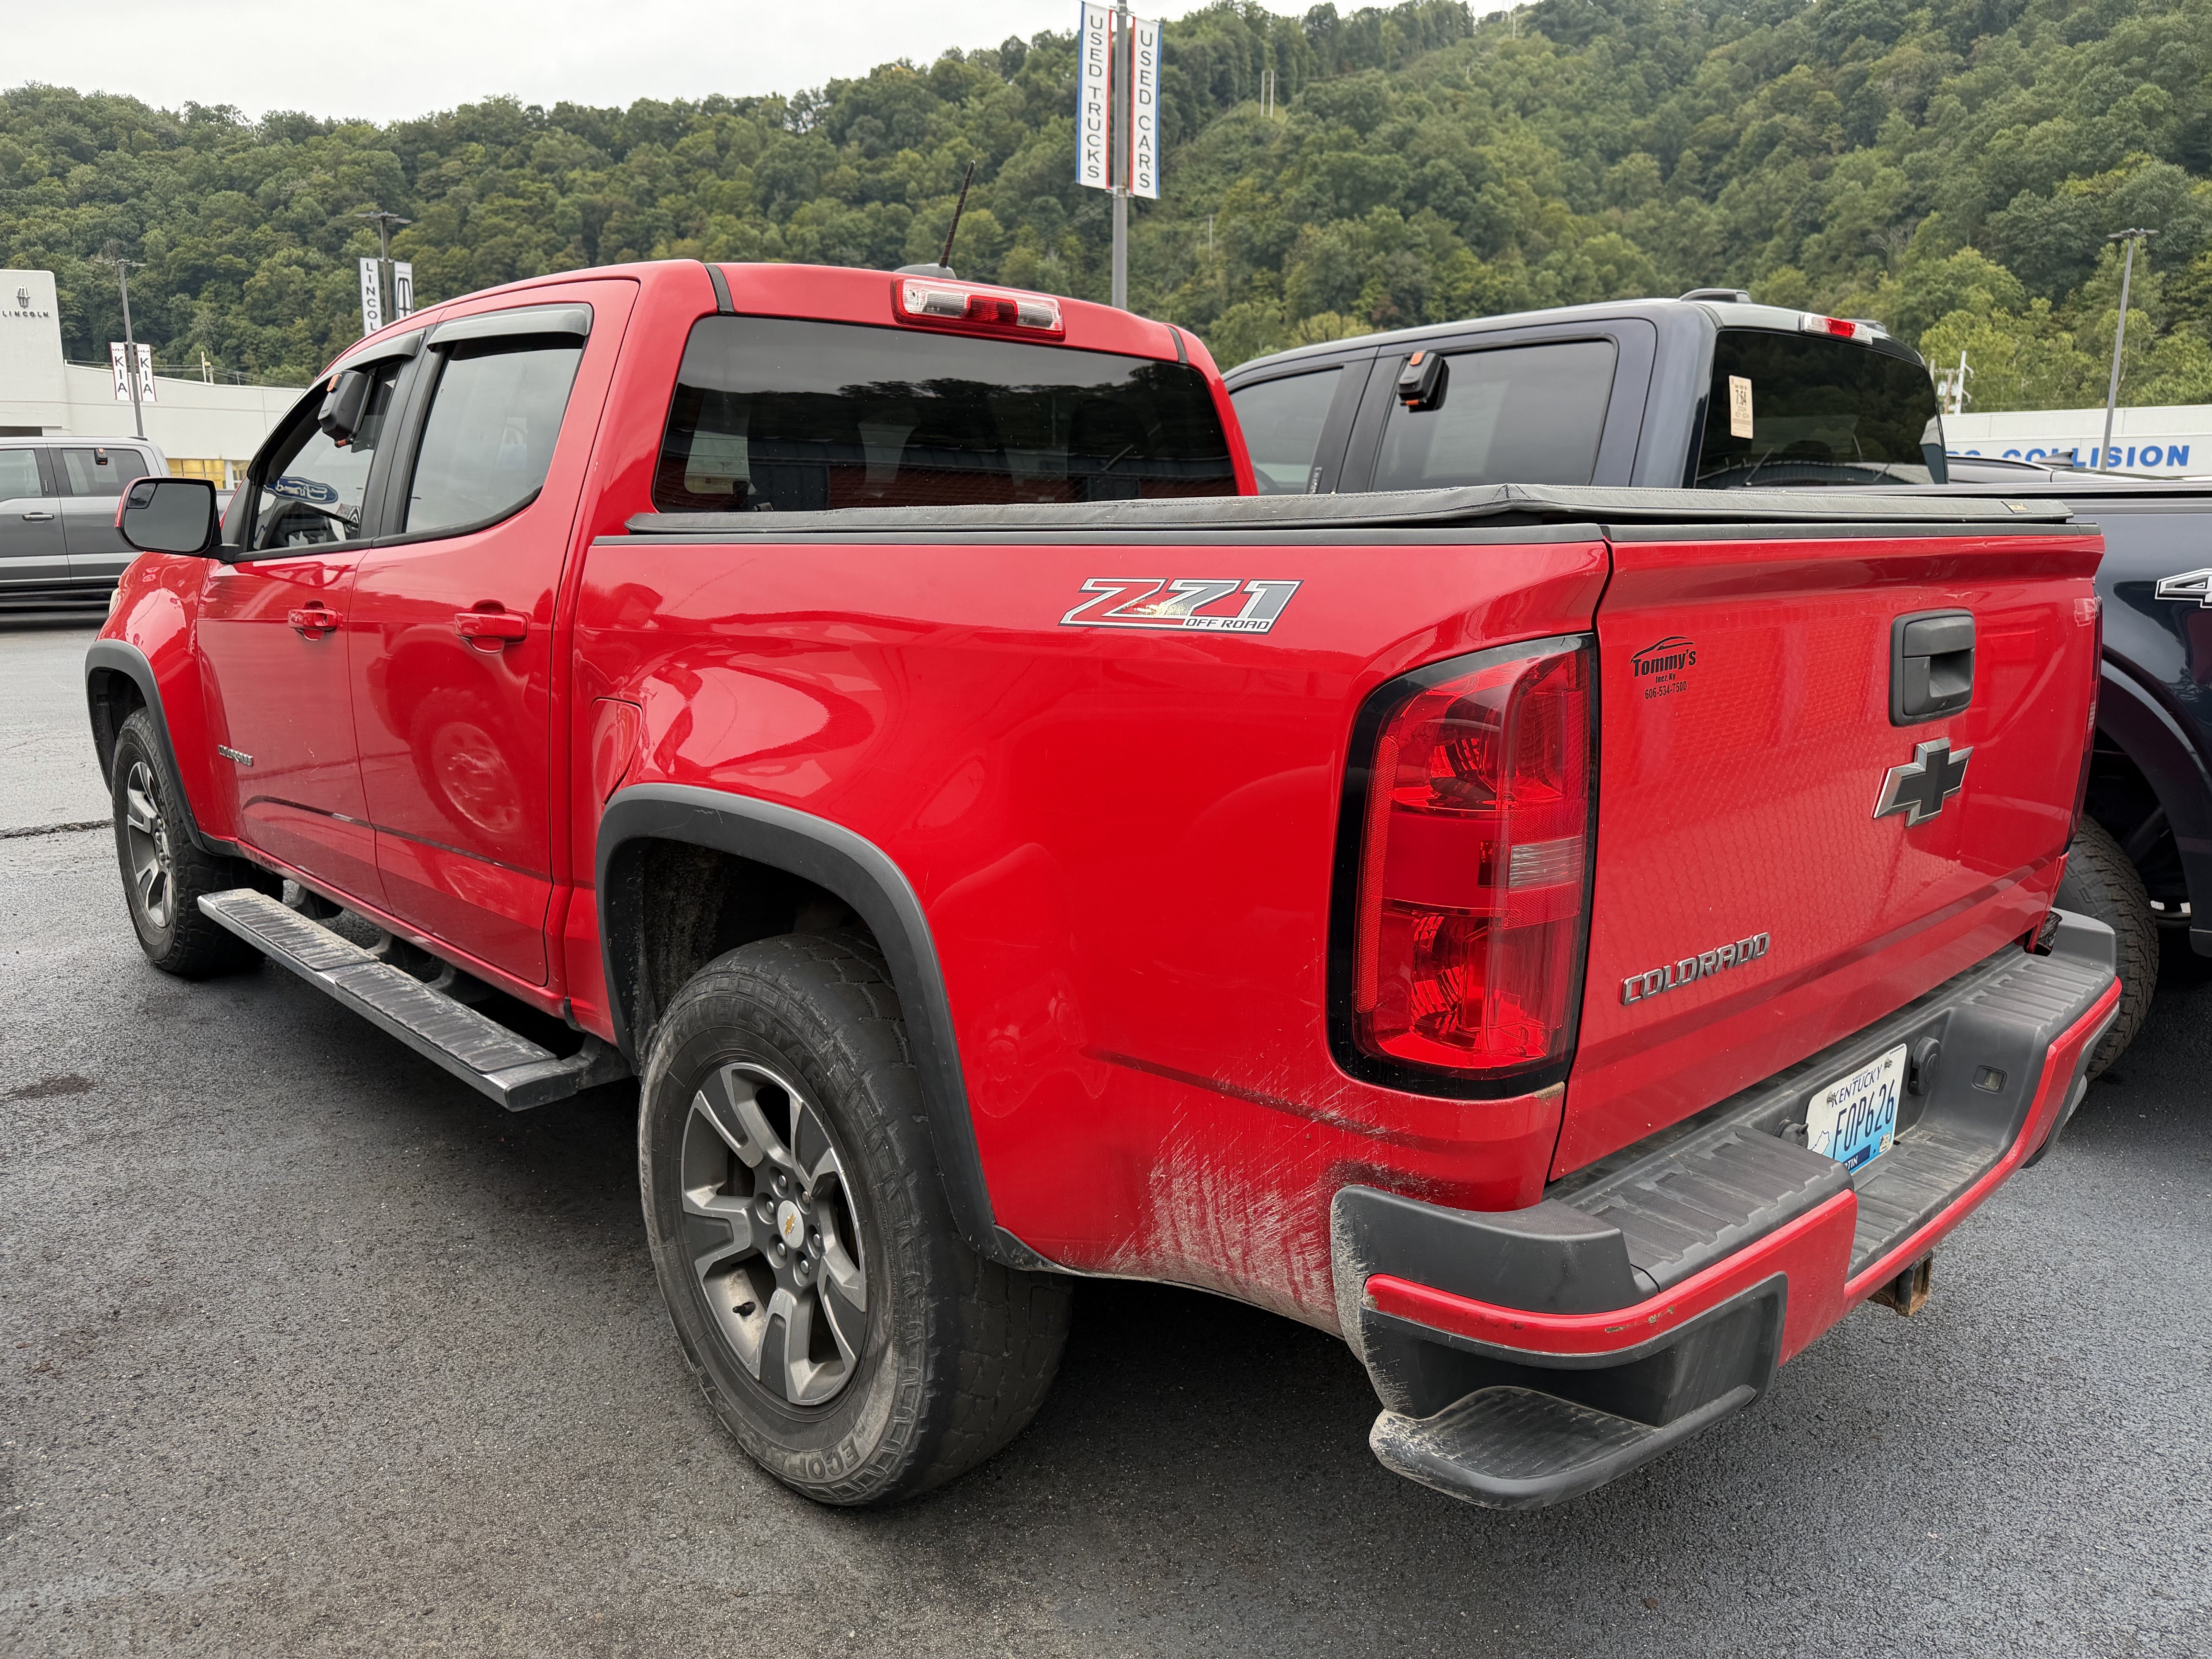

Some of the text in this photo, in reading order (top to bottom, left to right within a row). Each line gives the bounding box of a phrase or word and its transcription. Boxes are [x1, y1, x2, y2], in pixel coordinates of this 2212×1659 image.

[1087, 15, 1103, 179] USED TRUCKS
[1139, 30, 1152, 188] USED CARS
[114, 356, 127, 393] KIA
[140, 357, 153, 393] KIA
[1058, 577, 1304, 630] Z71
[1185, 618, 1271, 629] OFF ROAD
[1632, 649, 1696, 677] Tommy's
[1645, 681, 1687, 699] 606-534-7500
[1621, 932, 1770, 1005] COLORADO
[1831, 1064, 1882, 1108] KENTUCKY
